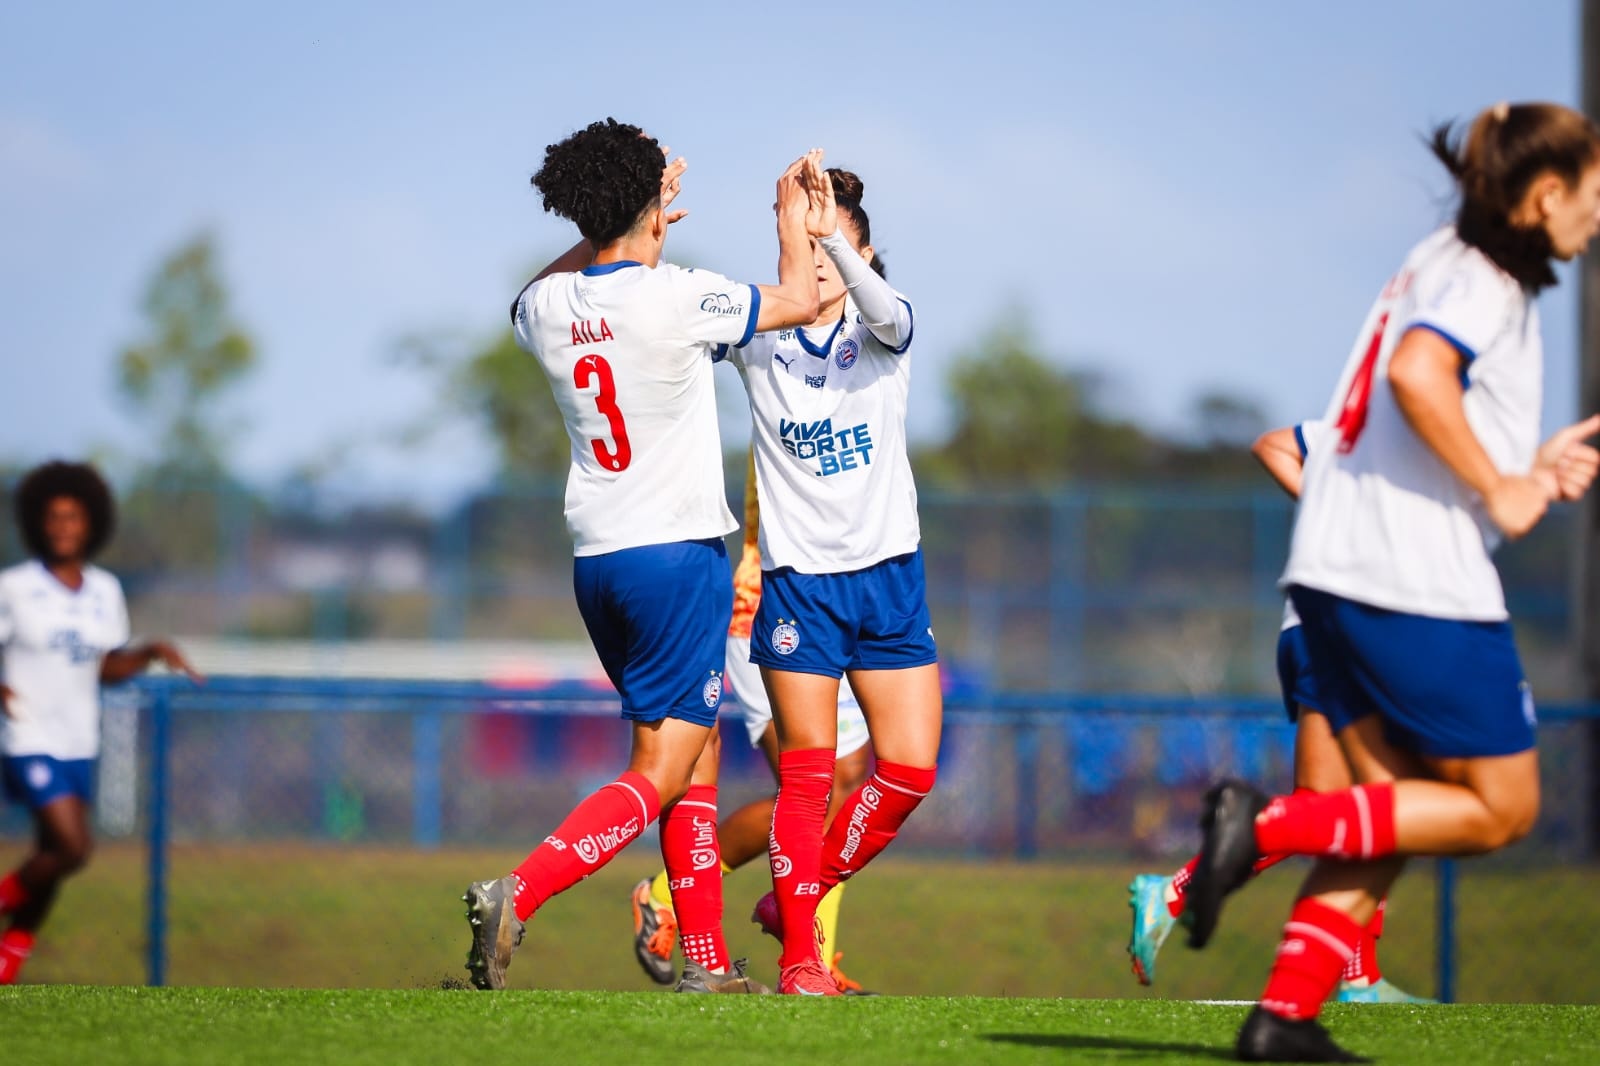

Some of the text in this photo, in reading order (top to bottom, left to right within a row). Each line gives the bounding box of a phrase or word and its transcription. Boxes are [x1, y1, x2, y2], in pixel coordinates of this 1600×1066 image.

[571, 317, 615, 346] AILA
[573, 353, 632, 472] 3
[780, 417, 833, 441] VIVA
[780, 422, 872, 460] SORTE
[815, 443, 874, 477] .BET
